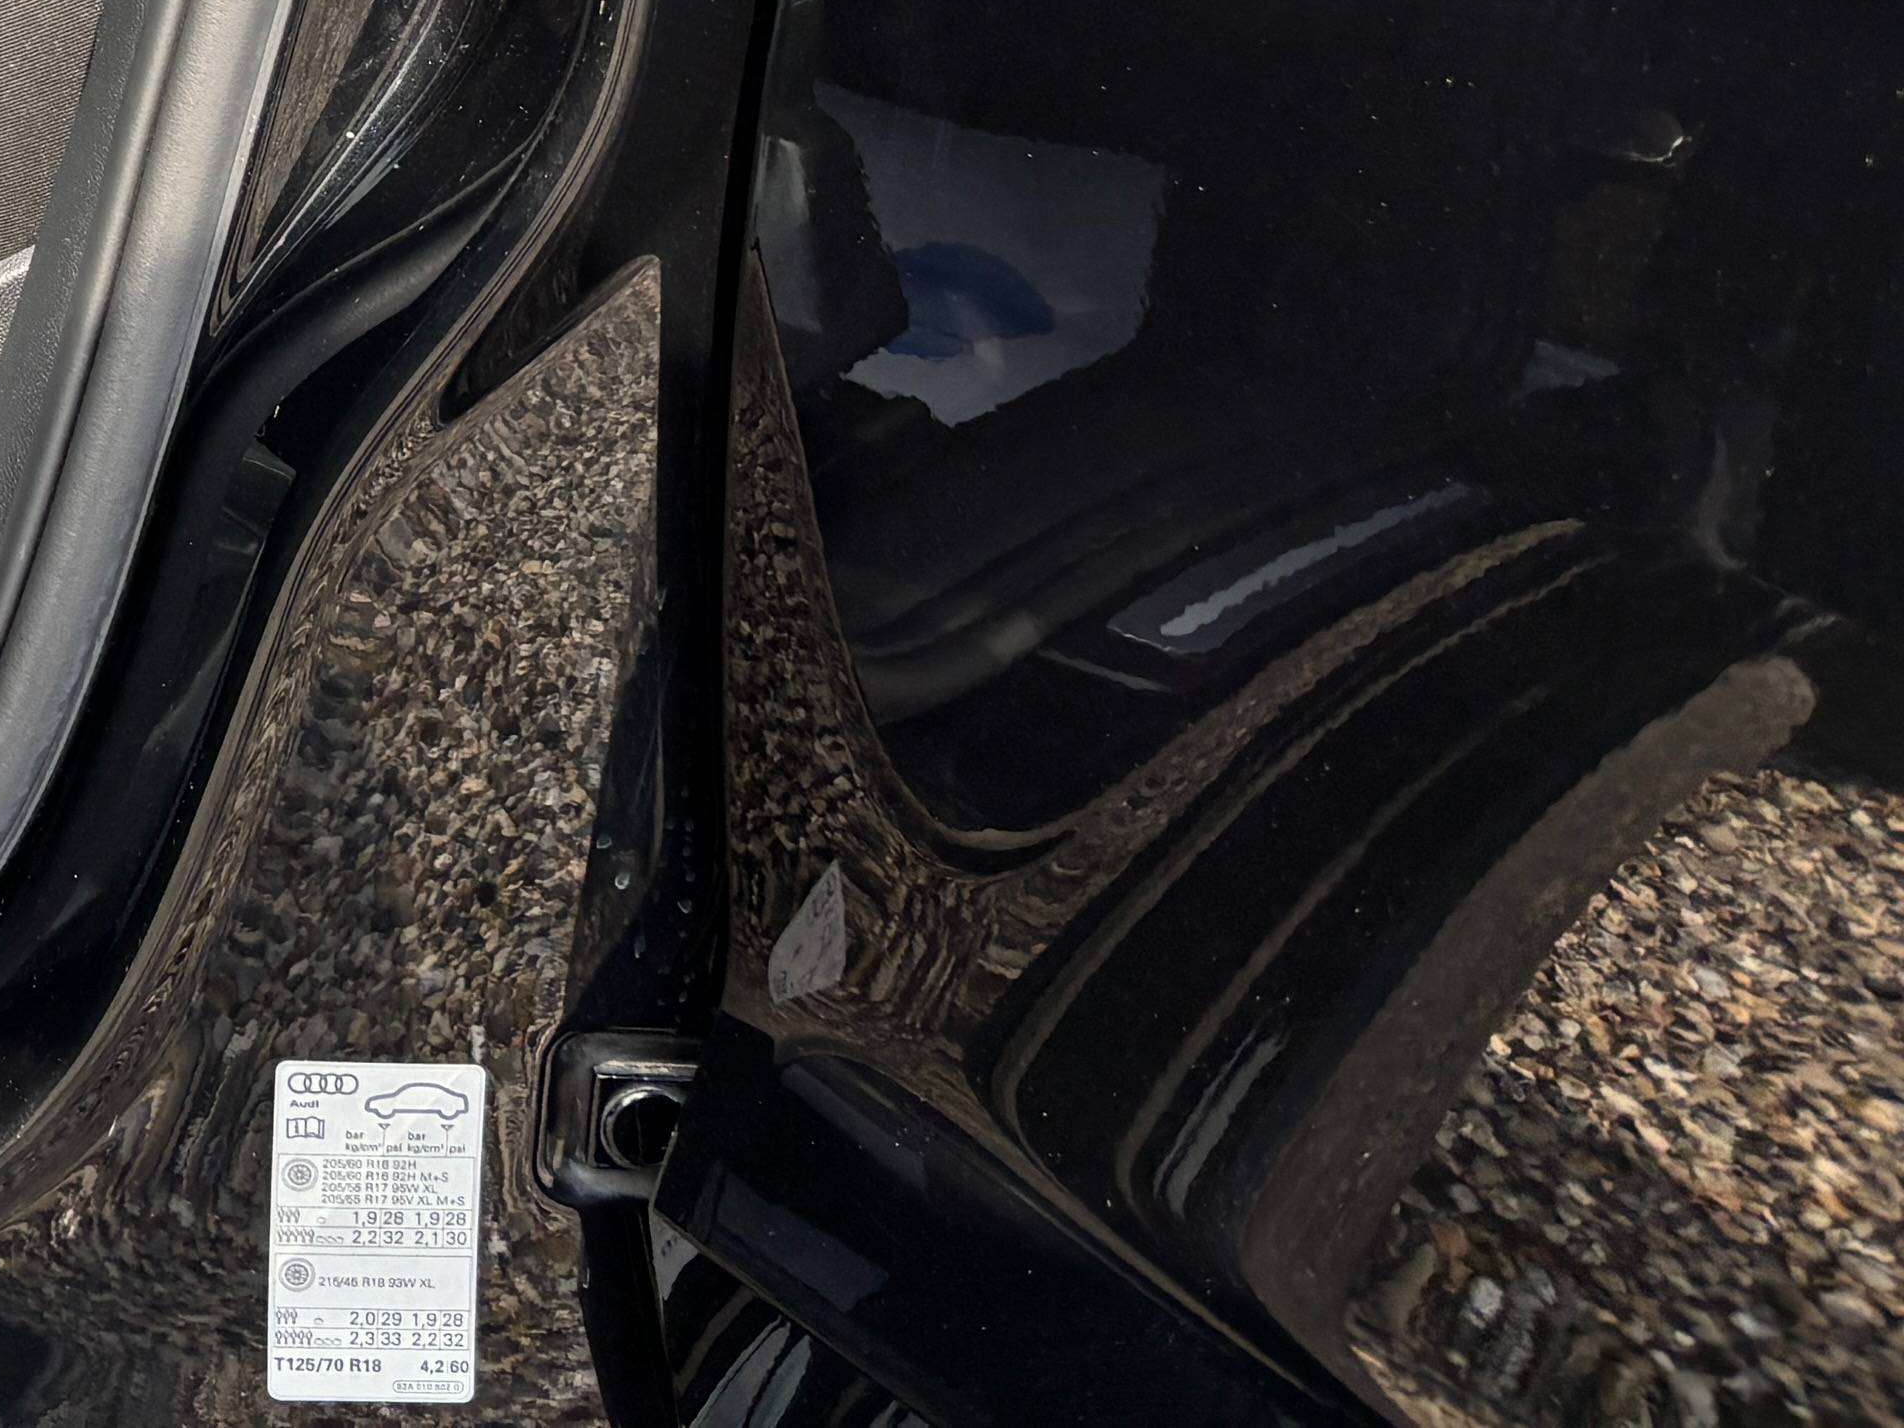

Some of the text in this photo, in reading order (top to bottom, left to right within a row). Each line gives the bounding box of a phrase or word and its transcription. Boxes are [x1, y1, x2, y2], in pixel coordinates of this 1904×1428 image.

[290, 1100, 319, 1108] Audi
[346, 1131, 426, 1140] bar bar
[393, 1160, 416, 1169] 92H
[393, 1172, 416, 1181] 92H
[366, 1183, 387, 1192] R17
[392, 1183, 418, 1193] 95W
[423, 1184, 436, 1193] XL
[365, 1195, 386, 1204] R17
[392, 1195, 413, 1205] 95V
[418, 1196, 432, 1205] XL
[353, 1212, 466, 1227] 1,9 28 1,9 28
[352, 1231, 467, 1246] 2,2 32 2,1 30
[388, 1278, 416, 1288] 93W
[350, 1312, 463, 1329] 2,0 29 1,9 28
[350, 1332, 463, 1348] 2,3 33 2,2 32
[274, 1358, 469, 1375] T125/70 R18 4,2 60
